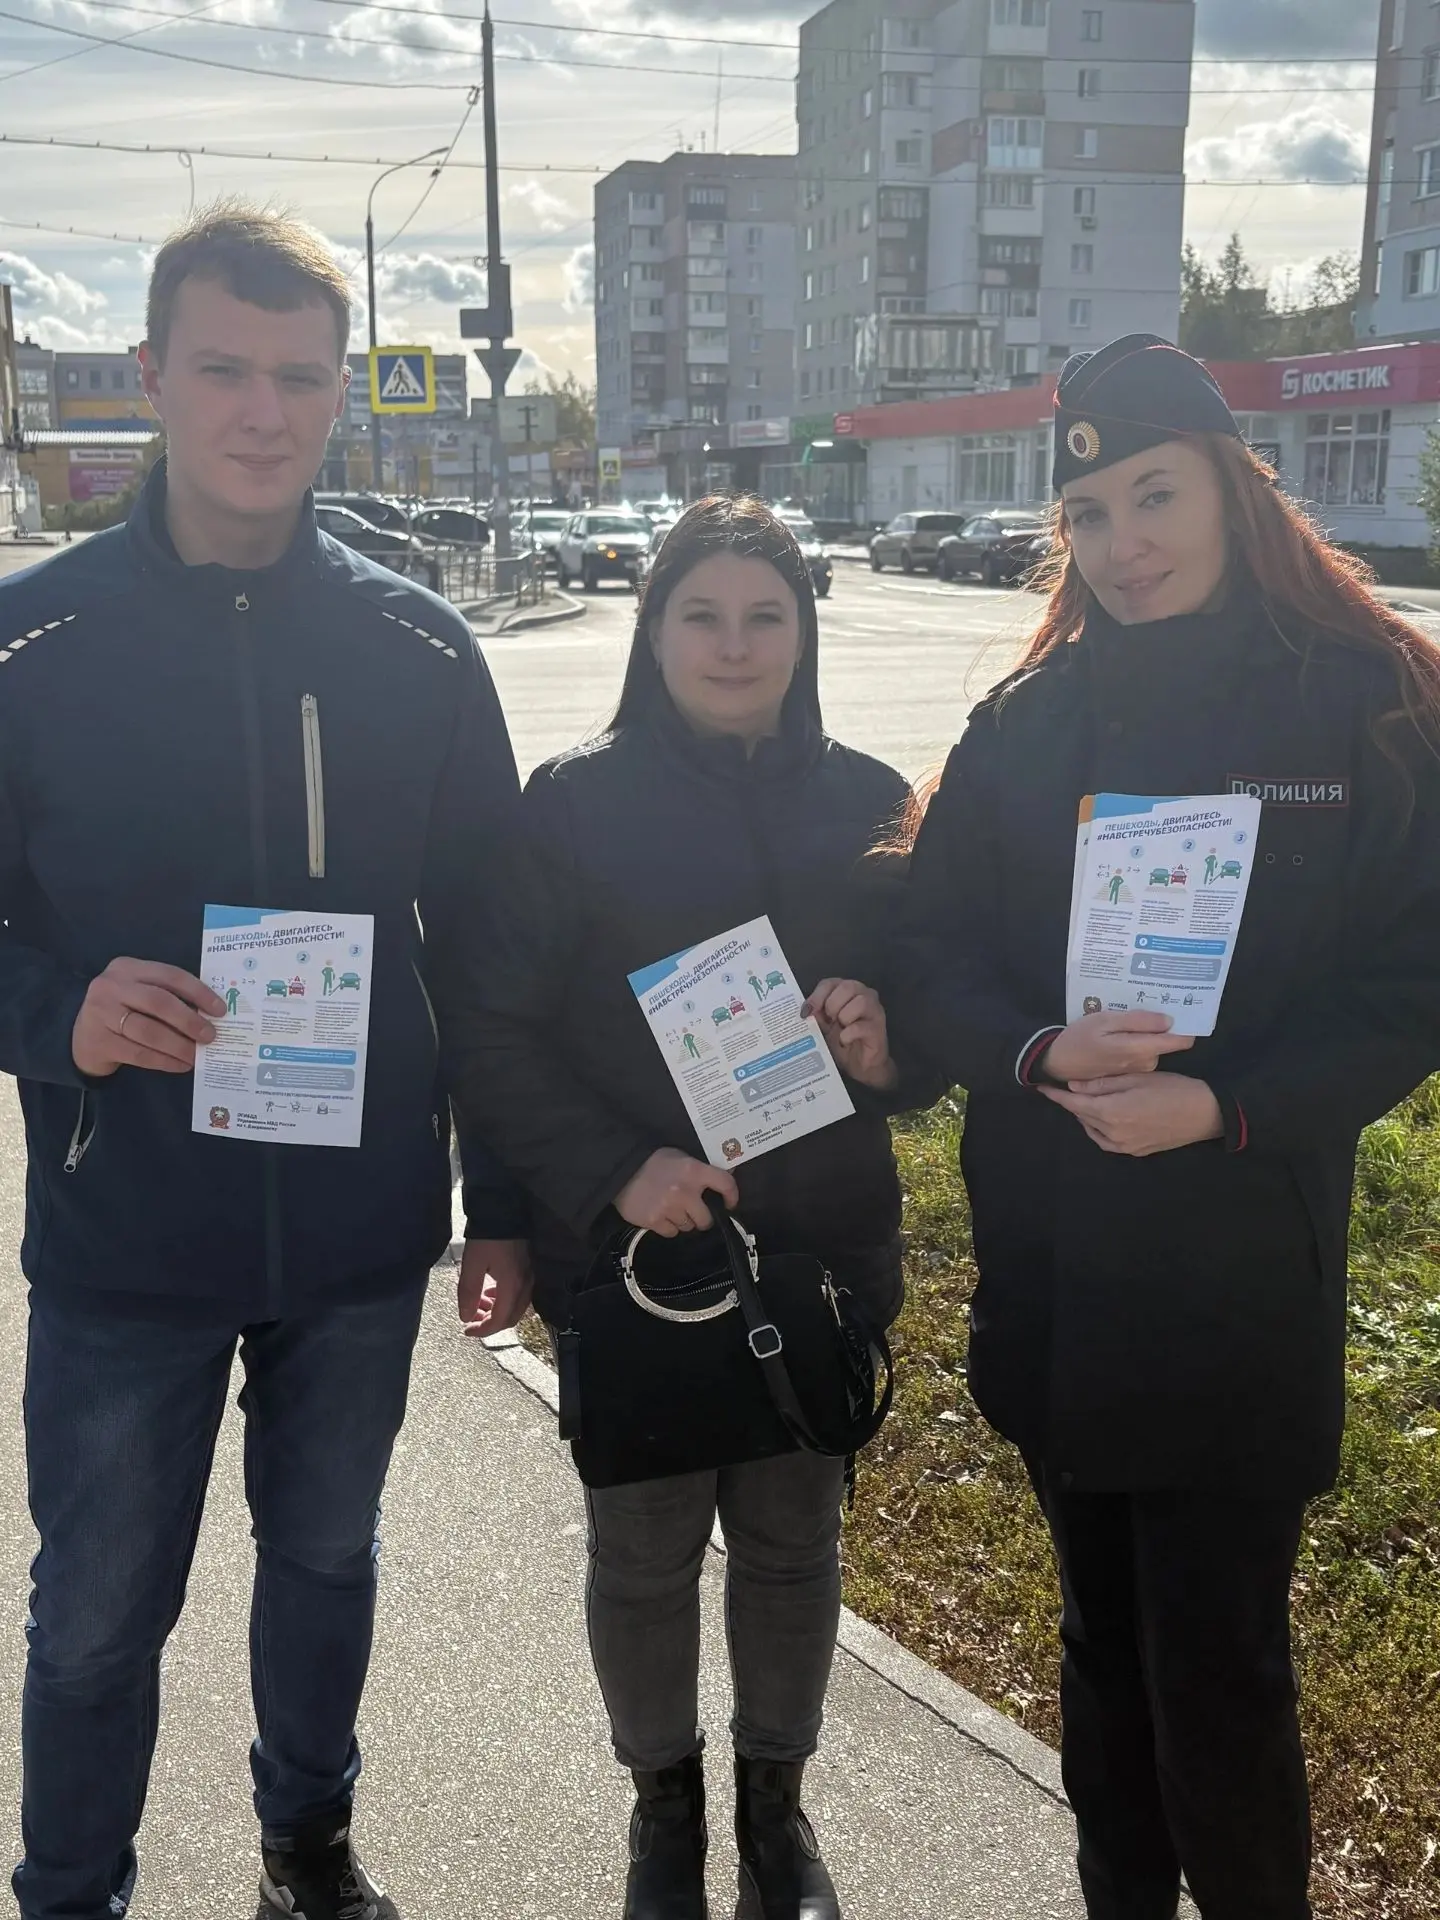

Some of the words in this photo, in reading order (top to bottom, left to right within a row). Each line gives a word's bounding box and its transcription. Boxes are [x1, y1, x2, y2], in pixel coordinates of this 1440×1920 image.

[1302, 365, 1390, 395] КОСМЕТИК
[1231, 780, 1343, 803] ПОЛИЦИЯ
[1097, 818, 1232, 841] #НАВСТРЕЧУБЕЗОПАСНОСТИ!
[1105, 819, 1160, 831] ПЕШЕХОДЫ,
[1162, 811, 1221, 827] ДВИГАЙТЕСЬ
[207, 931, 345, 953] #НАВСТРЕЧУБЕЗОПАСНОСТИ!
[213, 930, 271, 943] ПЕШЕХОДЫ,
[273, 924, 333, 938] ДВИГАЙТЕСЬ
[648, 971, 693, 1005] ПЕШЕХОДЫ,
[693, 940, 738, 975] ДВИГАЙТЕСЬ
[648, 940, 751, 1015] #НАВСТРЕЧУБЕЗОПАСНОСТИ!
